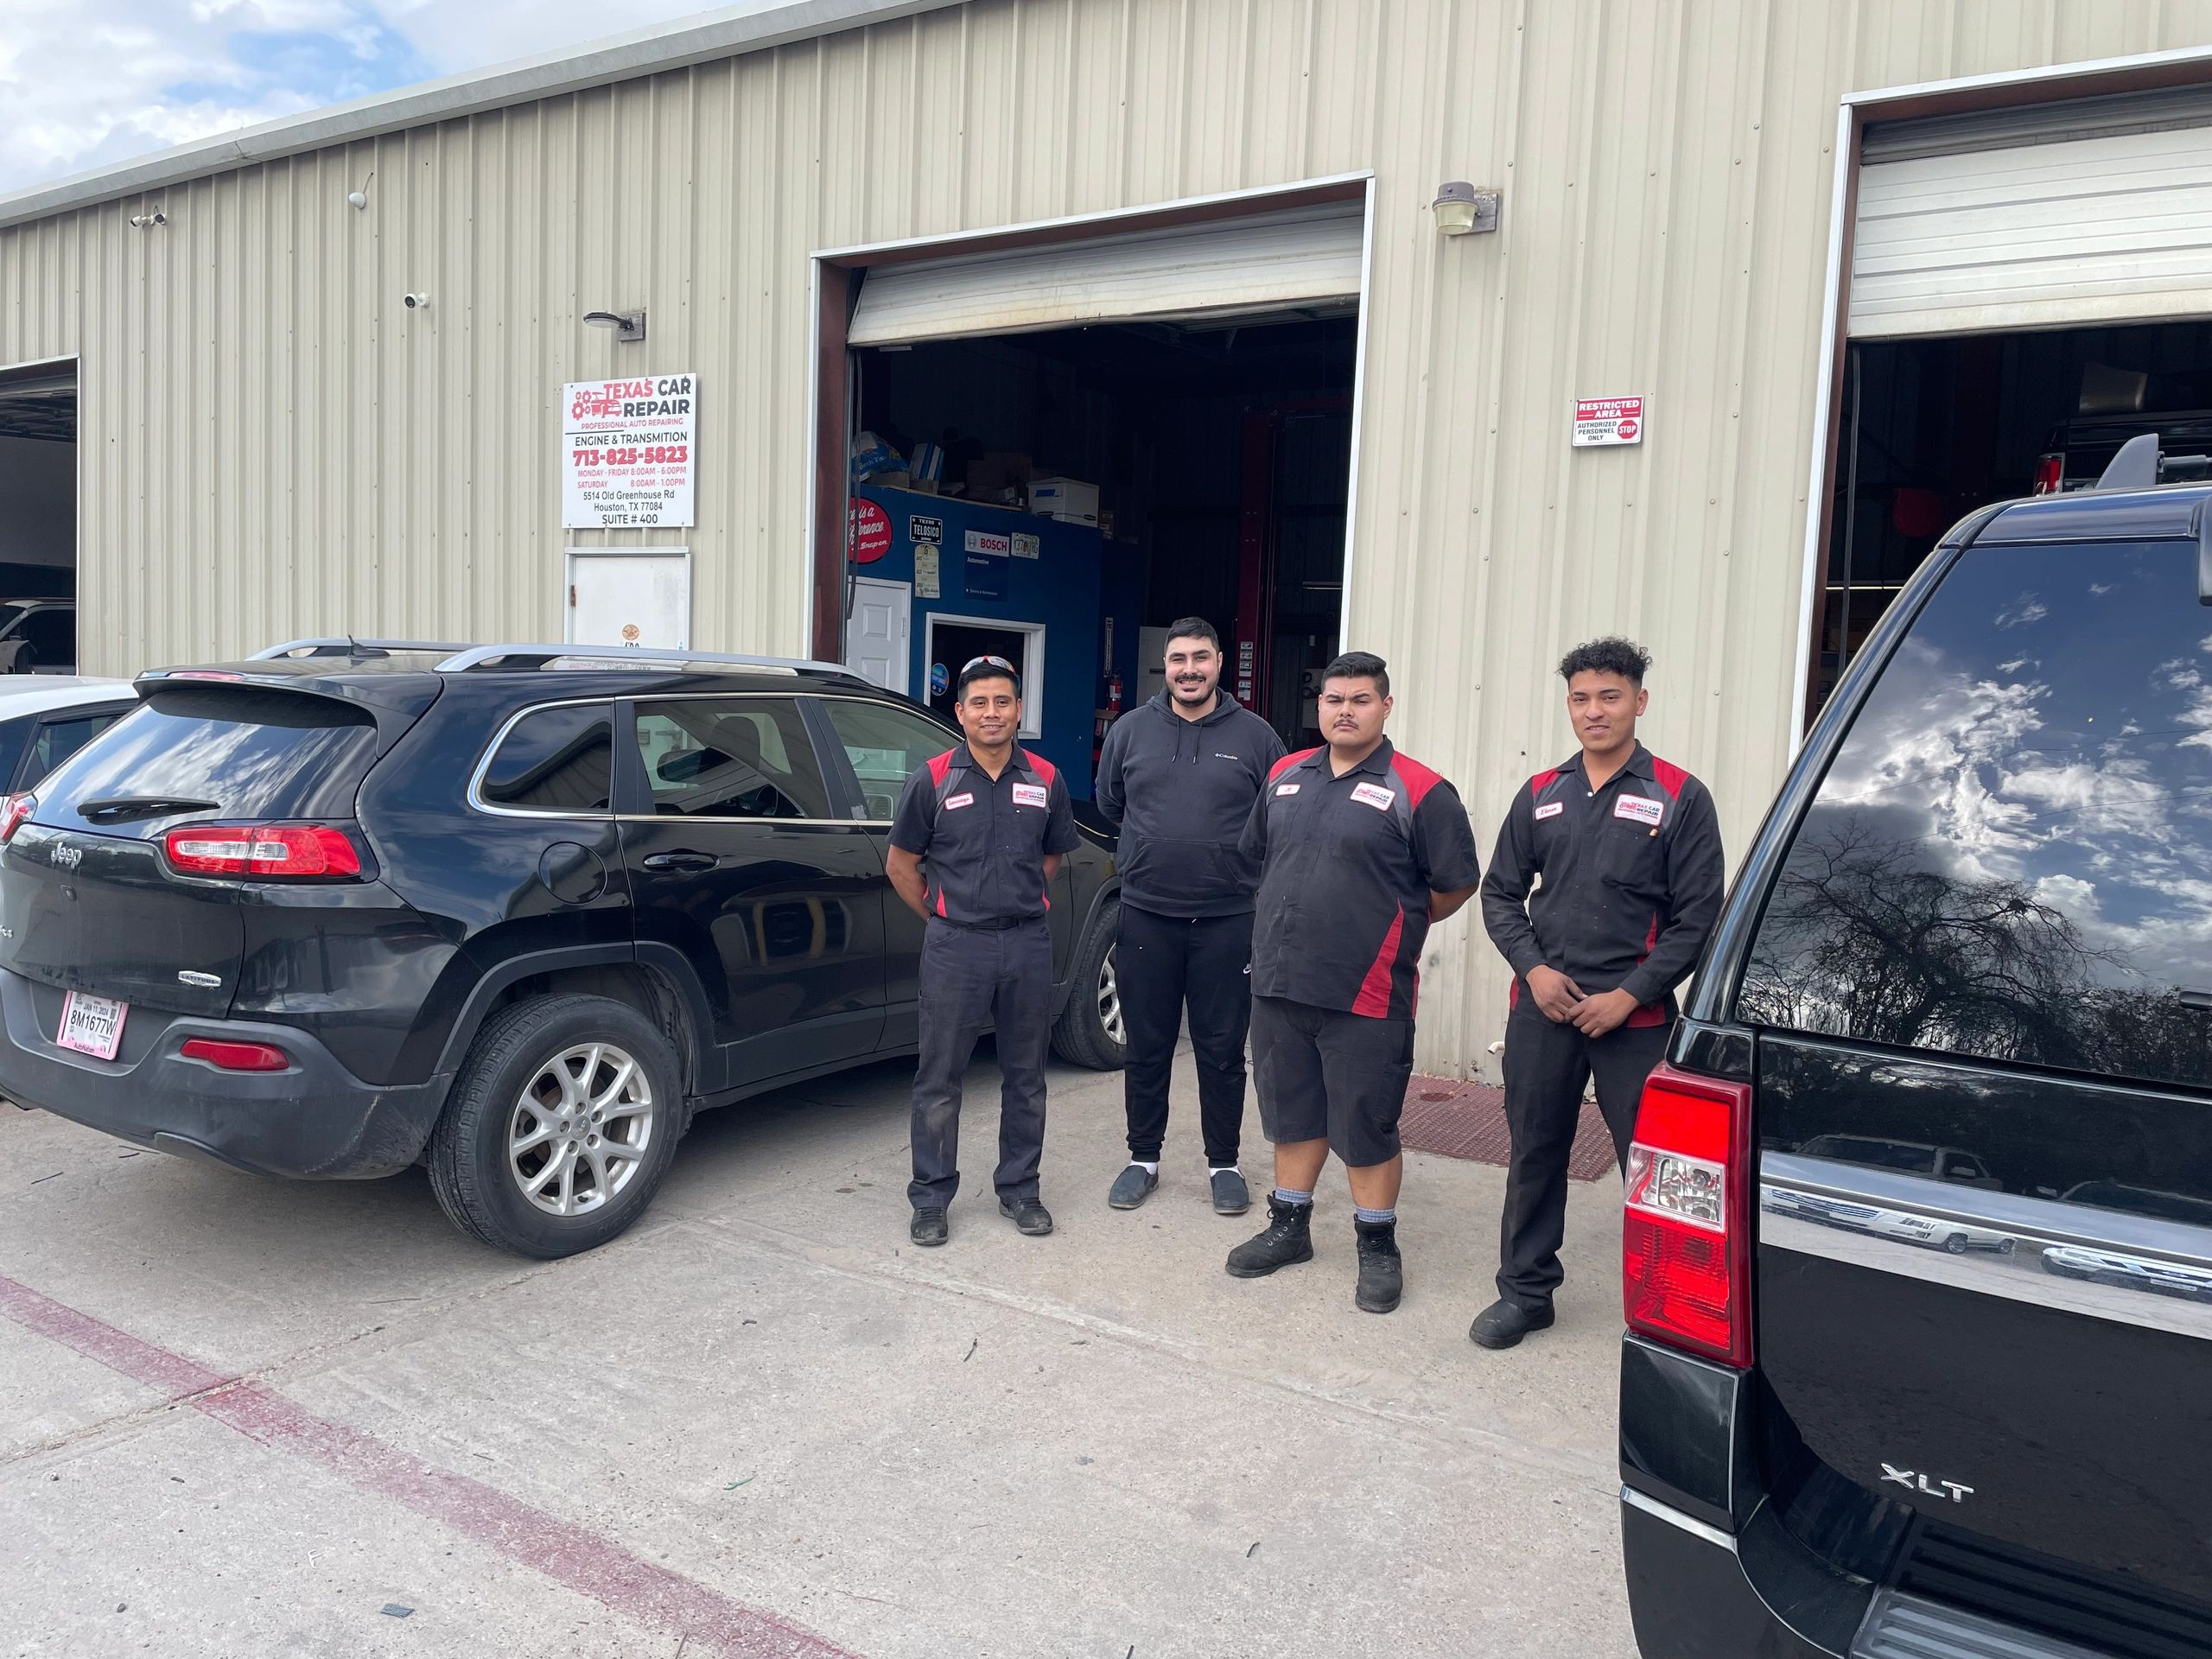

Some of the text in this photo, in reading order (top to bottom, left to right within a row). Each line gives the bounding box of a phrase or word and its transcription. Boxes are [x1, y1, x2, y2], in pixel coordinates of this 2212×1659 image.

[603, 378, 691, 399] TEXAS CAR
[624, 399, 690, 417] REPAIR
[1579, 400, 1640, 411] RESTRICTED
[1594, 410, 1622, 418] AREA
[581, 417, 683, 429] PROFESSIONAL AUTO REPAIRING
[1618, 425, 1637, 434] STOP
[575, 432, 688, 446] ENGINE & TRANSMITION
[573, 446, 688, 467] 713-825-5823
[608, 468, 629, 477] FRIDAY
[630, 467, 656, 476] 8:00AM
[577, 480, 608, 489] SATURDAY
[661, 478, 685, 486] 1:00PM
[583, 489, 675, 500] 5514 Old Greenhouse Rd
[594, 502, 663, 512] Houston, TX 77084
[601, 514, 658, 524] SUITE # 400
[980, 538, 1007, 552] BOSCH
[1637, 807, 1659, 817] REPAIR
[51, 842, 82, 869] Jeep
[84, 1002, 92, 1011] JAN
[99, 1006, 110, 1016] 2024
[70, 1009, 117, 1036] 8M1677W
[1881, 1463, 1974, 1503] XLT
